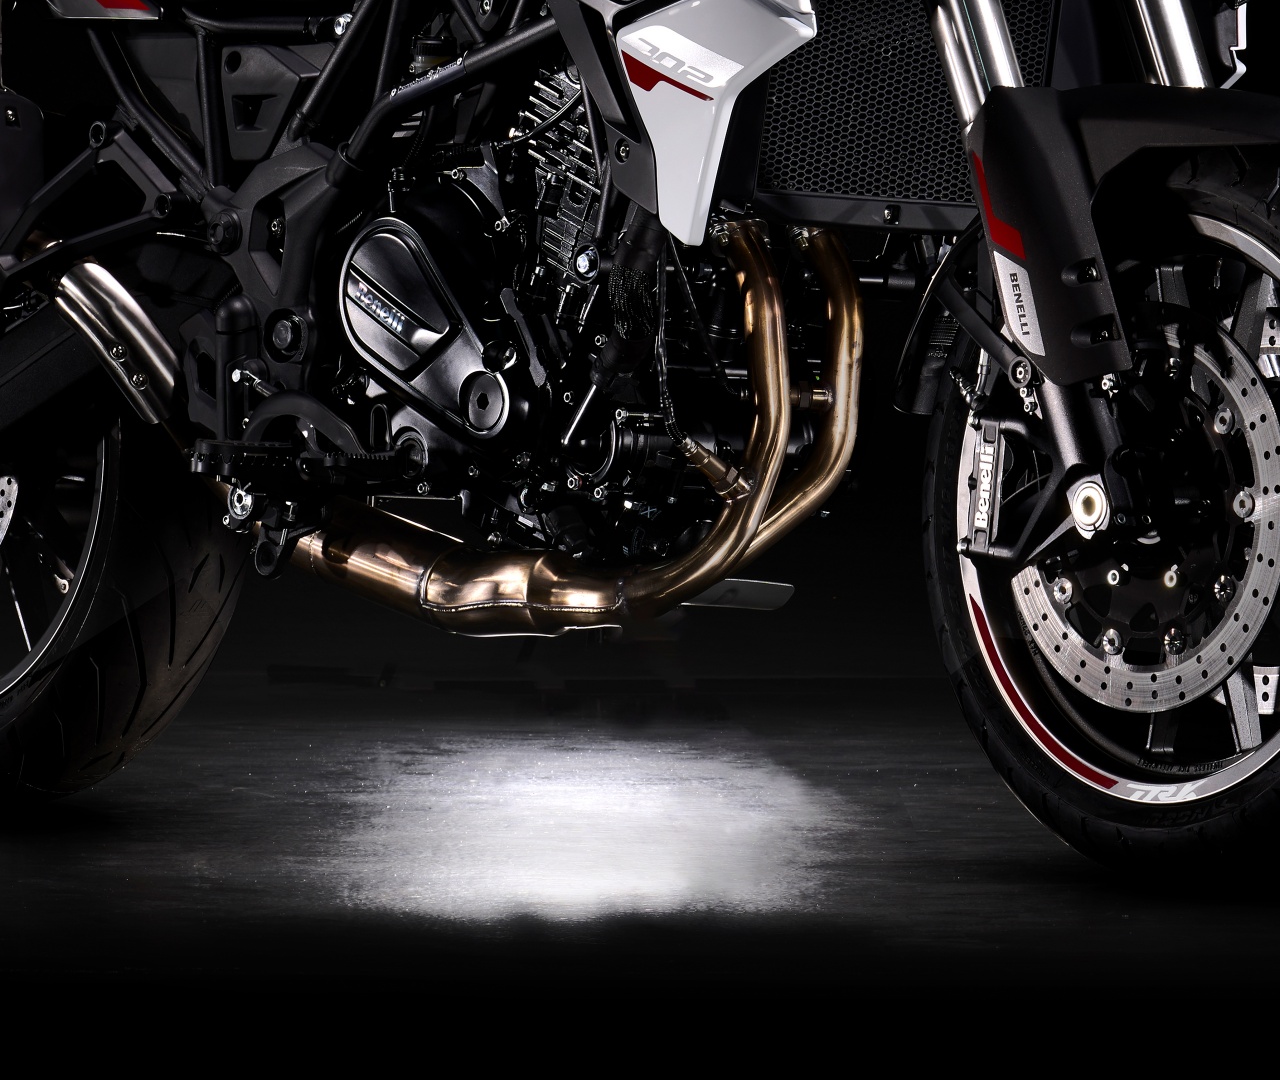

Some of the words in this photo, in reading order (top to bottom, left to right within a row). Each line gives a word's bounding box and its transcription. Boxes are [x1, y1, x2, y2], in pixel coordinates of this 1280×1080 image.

[637, 37, 715, 85] 702
[354, 281, 406, 333] Benelli
[1009, 272, 1030, 336] BENELLI
[974, 445, 995, 528] Benelli
[1126, 780, 1208, 800] TRK
